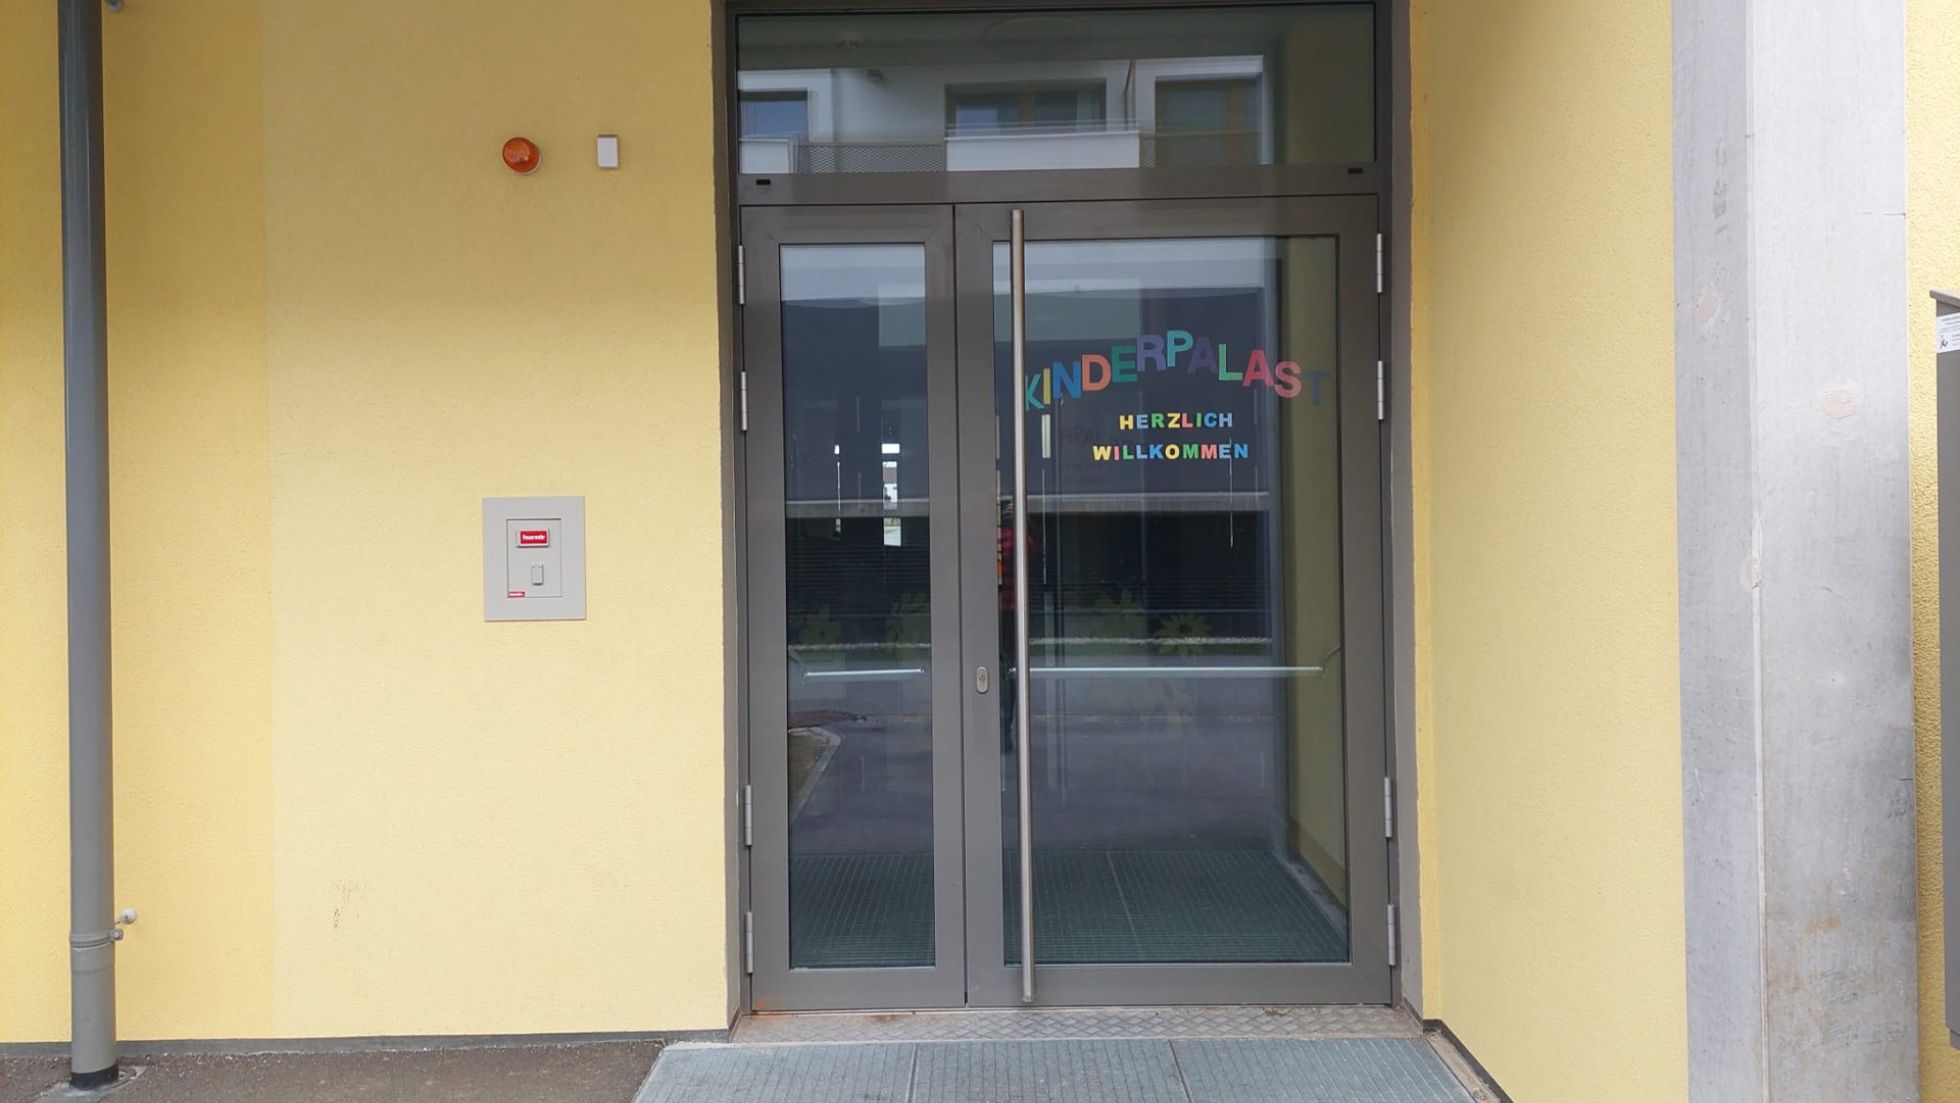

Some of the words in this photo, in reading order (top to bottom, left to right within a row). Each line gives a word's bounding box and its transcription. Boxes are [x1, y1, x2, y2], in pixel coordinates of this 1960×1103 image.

[1025, 330, 1329, 411] KINDERPALAST
[1119, 413, 1233, 430] HERZLICH
[1093, 443, 1248, 461] WILLKOMMEN
